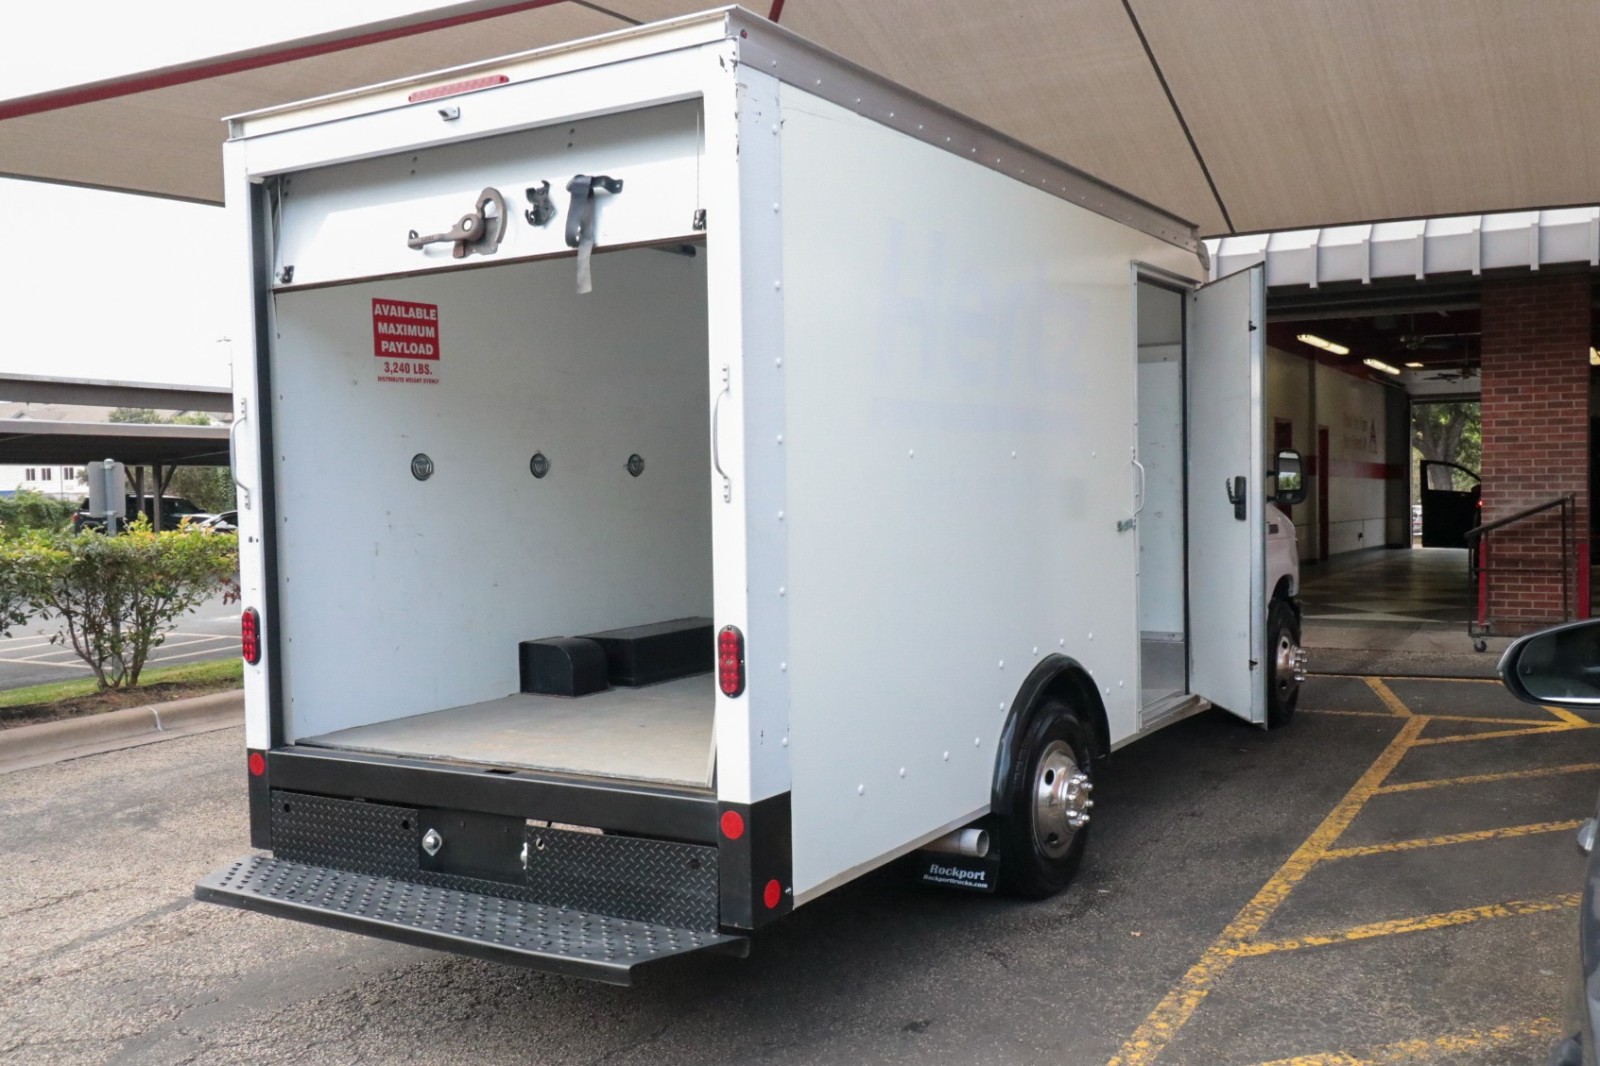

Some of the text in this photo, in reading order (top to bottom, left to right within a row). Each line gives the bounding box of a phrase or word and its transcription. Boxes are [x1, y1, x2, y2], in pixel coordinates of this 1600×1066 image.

[374, 304, 437, 320] AVAILABLE
[877, 218, 1090, 392] Hertz
[378, 322, 435, 338] MAXIMUM
[381, 340, 433, 355] PAYLOAD
[384, 362, 432, 375] 3,240 LBS.
[929, 864, 985, 880] Rockport
